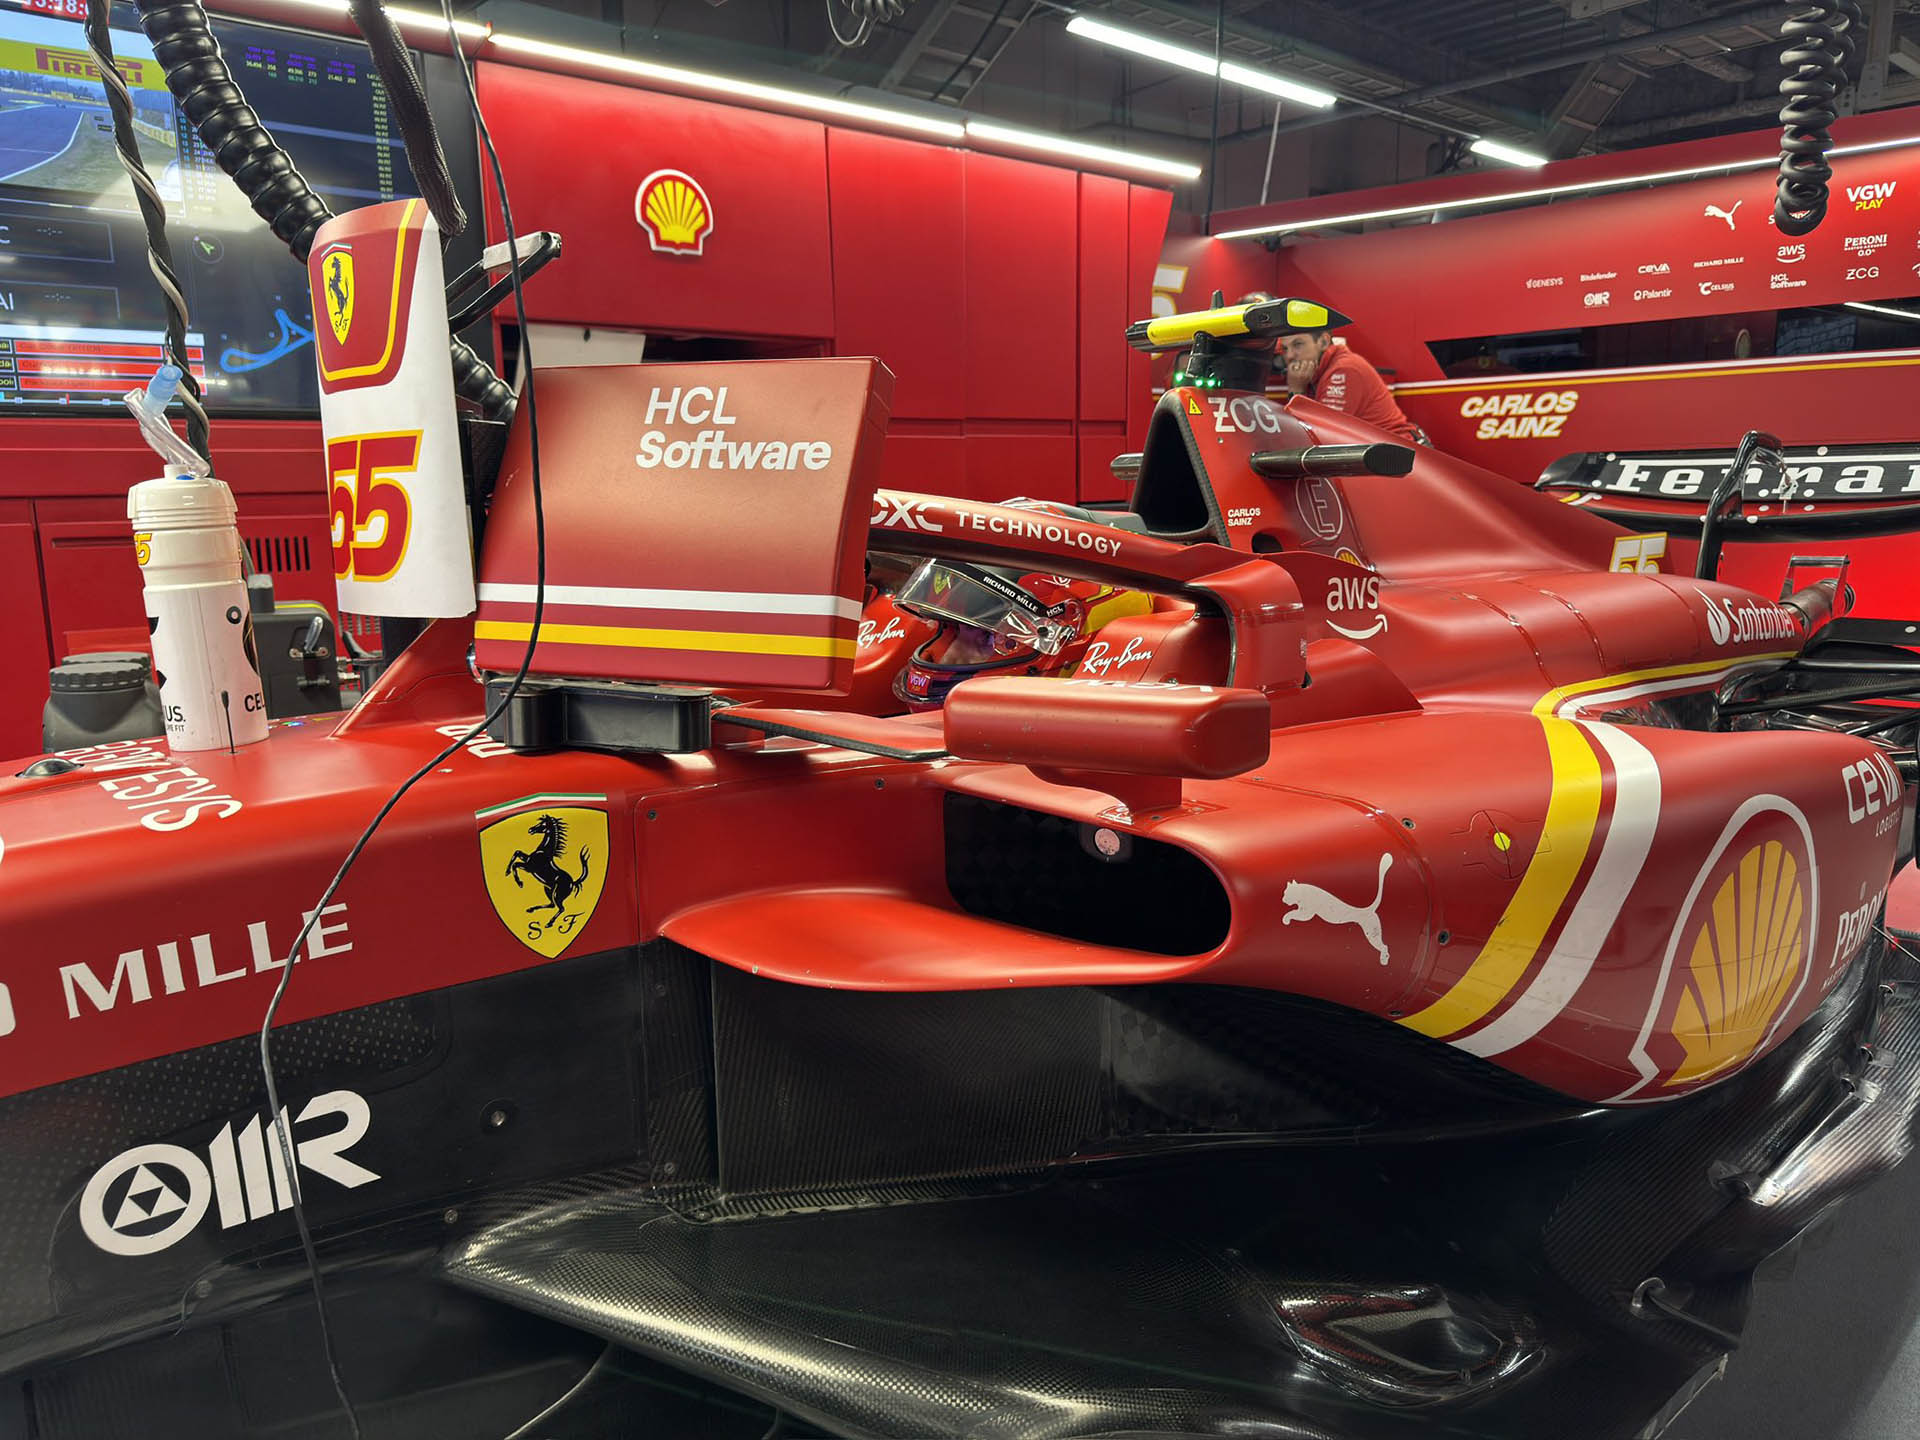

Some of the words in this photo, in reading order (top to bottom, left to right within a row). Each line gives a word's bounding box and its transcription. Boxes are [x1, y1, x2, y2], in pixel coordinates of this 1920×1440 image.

[36, 48, 143, 83] PIRELI
[1846, 182, 1896, 202] VGW
[1855, 199, 1884, 211] PLAY
[1777, 244, 1805, 257] aws
[1844, 234, 1888, 247] PERONI
[1724, 257, 1744, 265] MILLE
[1845, 267, 1880, 281] ZCG
[1533, 277, 1563, 288] GENESYS
[1770, 273, 1789, 282] HCL
[1770, 280, 1807, 289] Software
[1643, 287, 1673, 299] Palantir
[644, 387, 737, 427] HCL
[1208, 397, 1281, 433] ZCG
[1460, 390, 1579, 419] CARLOS
[1476, 414, 1568, 440] SAINZ
[635, 430, 832, 471] Software
[327, 429, 424, 583] 55
[1228, 507, 1261, 519] CARLOS
[955, 510, 1122, 557] TECHNOLOGY
[1228, 516, 1253, 527] SAINZ
[983, 576, 1016, 600] RICHARD
[1015, 595, 1039, 613] MILLE
[1326, 576, 1380, 613] aws
[1046, 604, 1065, 617] HCL
[1727, 597, 1796, 644] Santander
[857, 616, 905, 647] Ray-Ban
[1082, 637, 1153, 676] Ray-Ban
[71, 747, 243, 832] GNESYS
[59, 902, 354, 1020] MILLE
